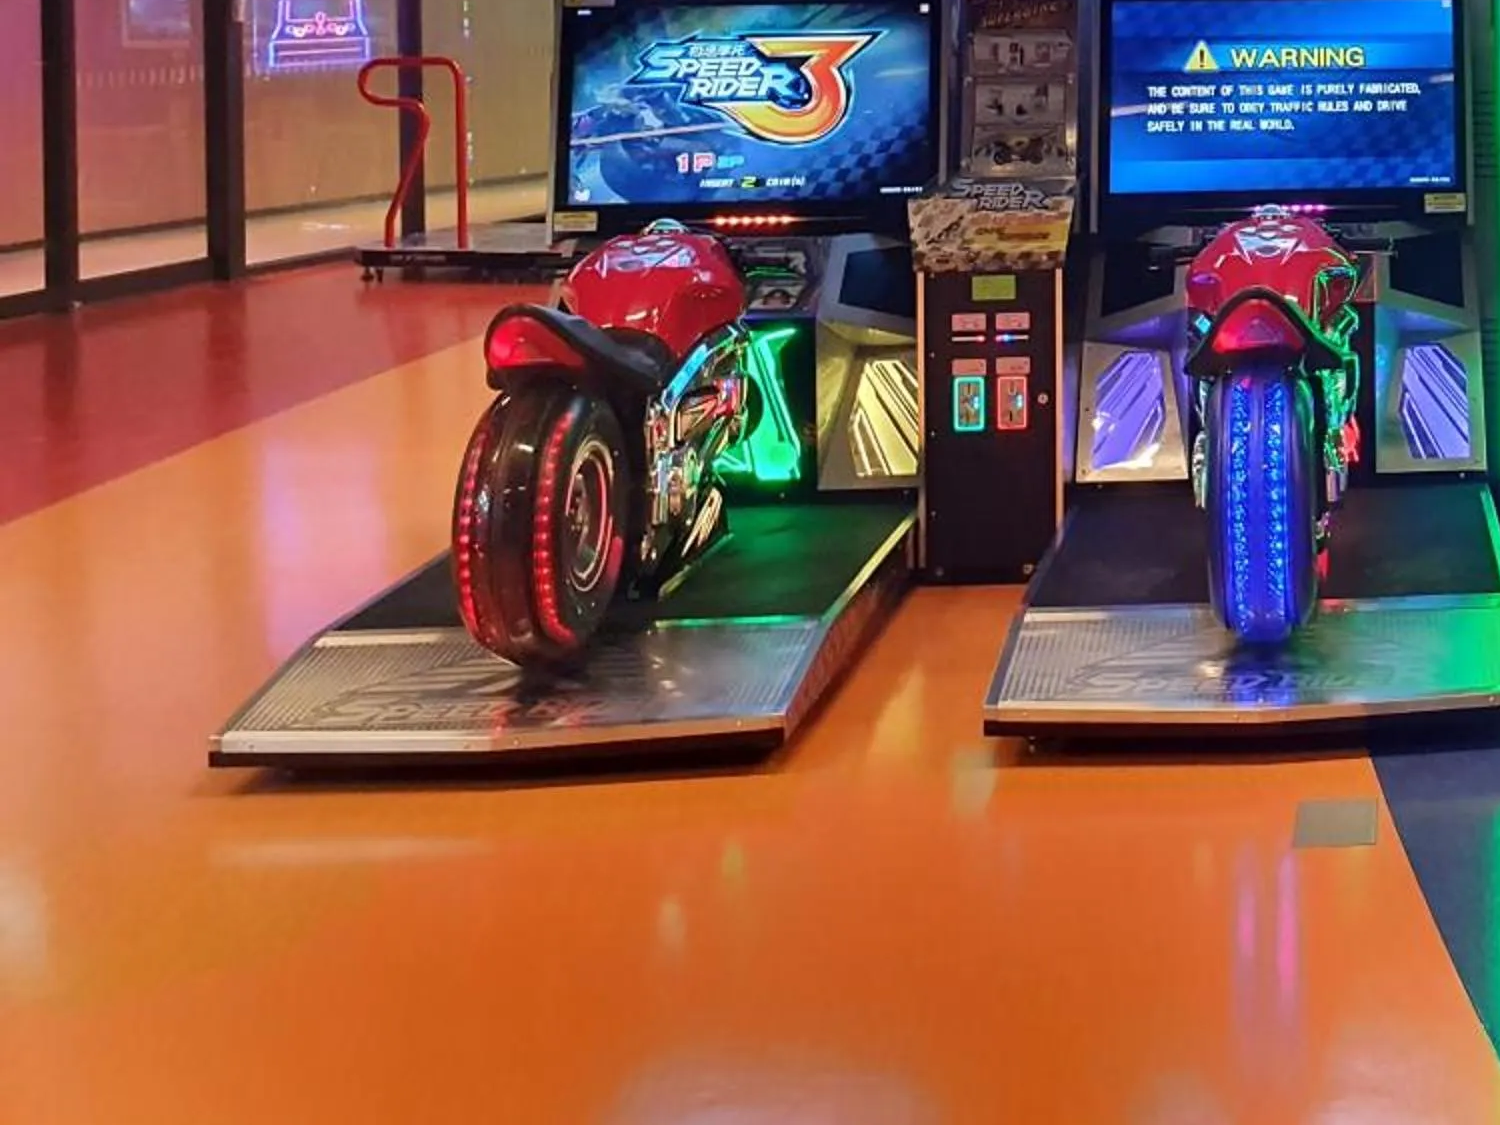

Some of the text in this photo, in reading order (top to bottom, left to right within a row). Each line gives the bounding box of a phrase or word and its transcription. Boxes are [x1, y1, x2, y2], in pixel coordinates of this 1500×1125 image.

[638, 45, 763, 79] SPEED
[1231, 46, 1365, 68] WARNING
[690, 64, 796, 98] RIDER
[703, 34, 874, 141] 3
[1147, 86, 1167, 97] THE
[1171, 85, 1217, 97] CONTENT
[1220, 84, 1234, 96] OF
[1301, 83, 1312, 95] IS
[1317, 83, 1355, 95] PURELY
[1147, 103, 1167, 115] AND
[1189, 102, 1216, 114] SURE
[1222, 102, 1235, 114] TO
[1317, 100, 1349, 112] RULES
[1353, 100, 1373, 112] AND
[1377, 100, 1407, 112] DRIVE
[1147, 120, 1185, 132] SAFELY
[1189, 120, 1203, 132] IN
[1207, 120, 1225, 131] THE
[1229, 119, 1254, 130] REAL
[740, 176, 757, 188] 2
[951, 178, 1025, 197] SPEED
[977, 188, 1049, 211] RIDER
